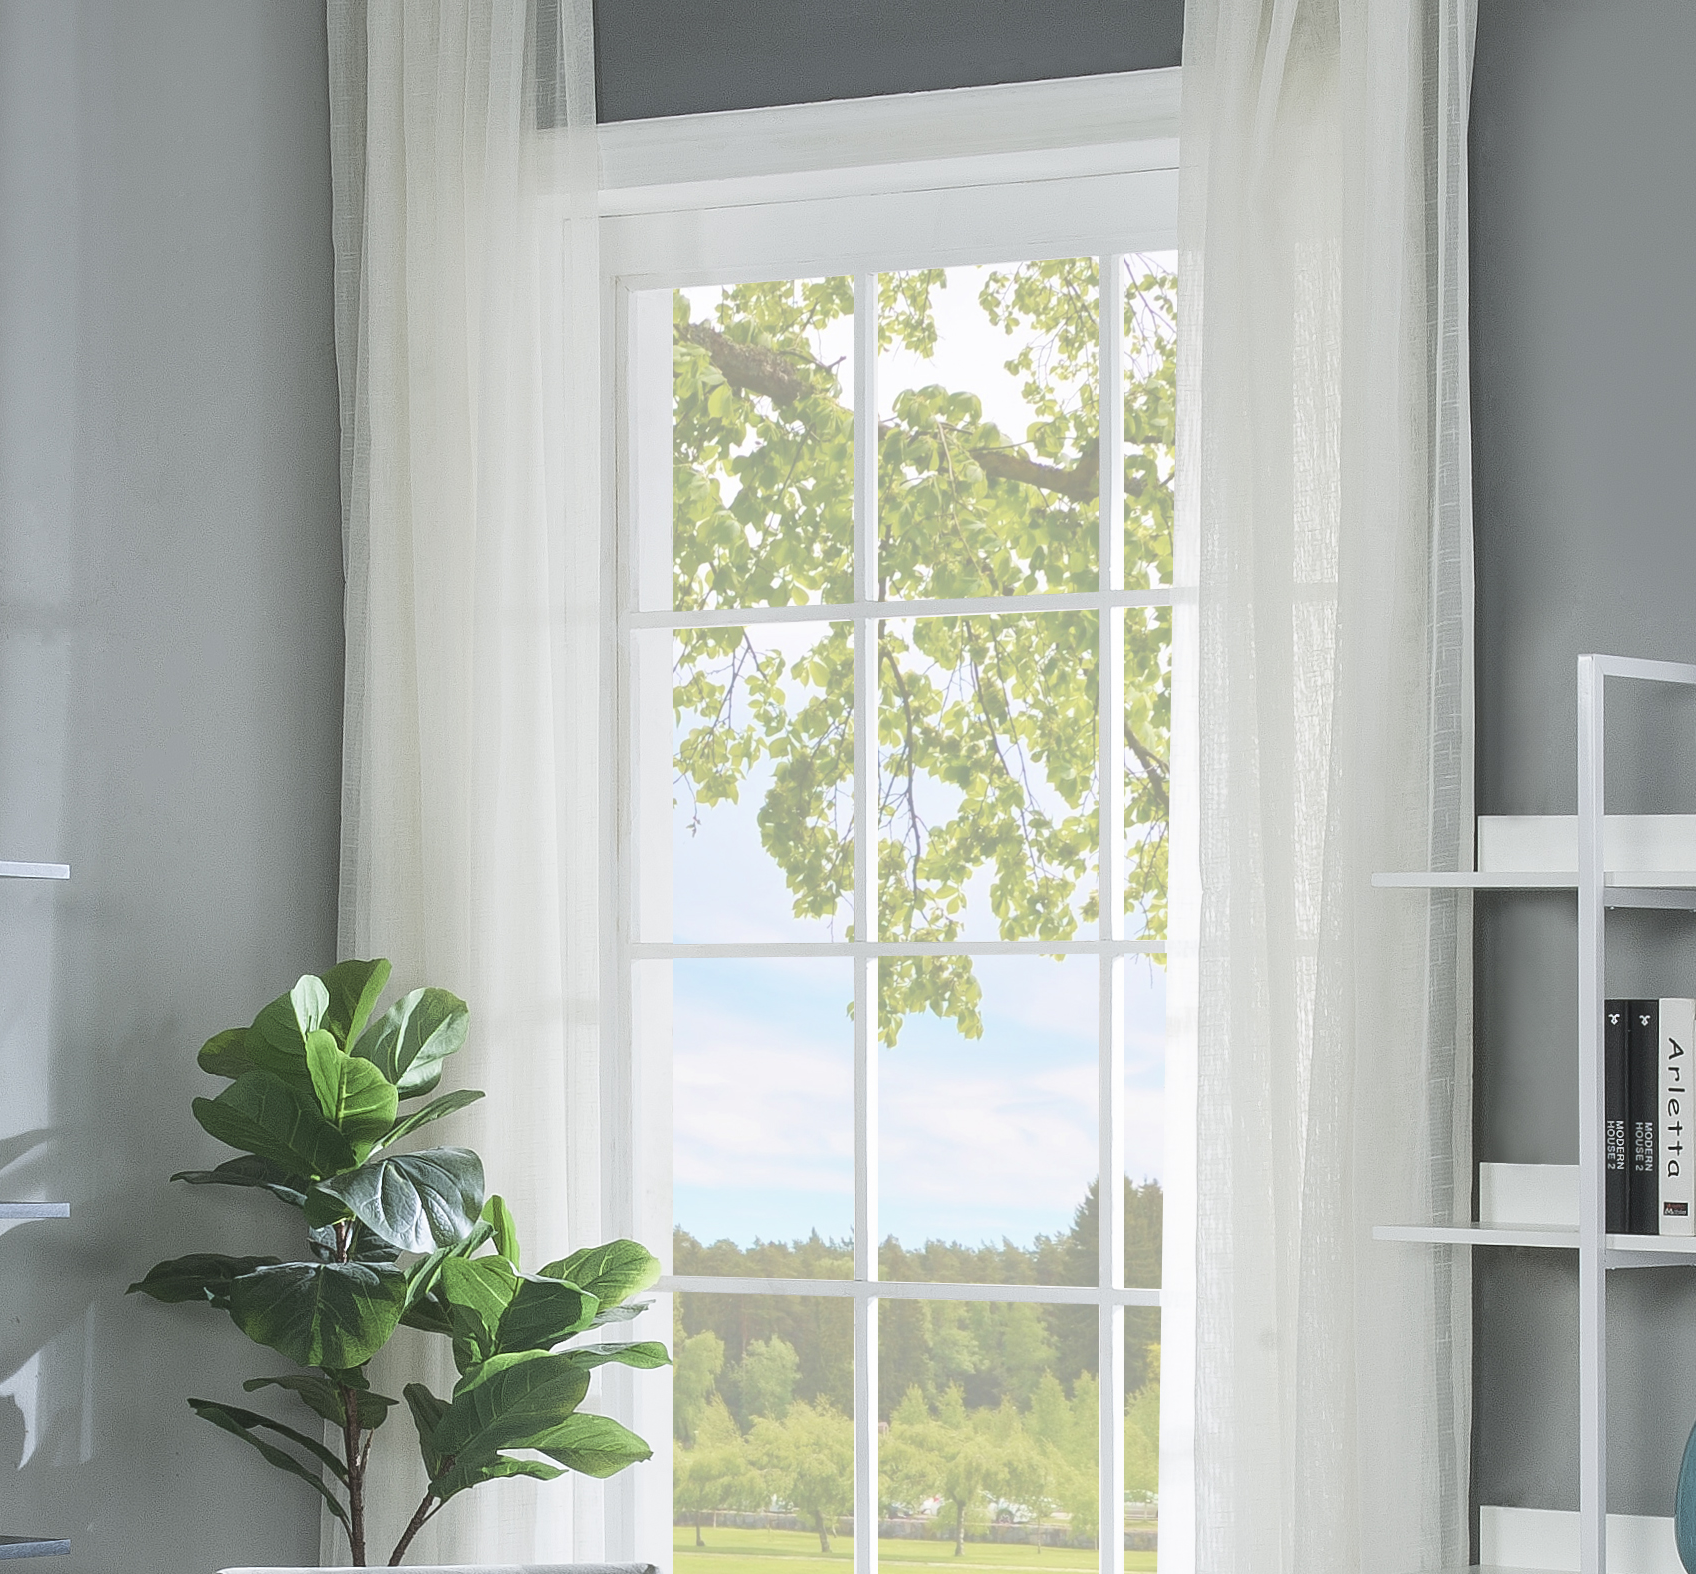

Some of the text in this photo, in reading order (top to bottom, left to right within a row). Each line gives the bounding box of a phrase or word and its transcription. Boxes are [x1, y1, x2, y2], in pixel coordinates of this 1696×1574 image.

[1667, 1037, 1685, 1178] Arletta
[1606, 1120, 1615, 1160] HOUSE
[1615, 1120, 1625, 1170] MODERN
[1635, 1122, 1644, 1161] HOUSE
[1644, 1122, 1653, 1172] MODERN
